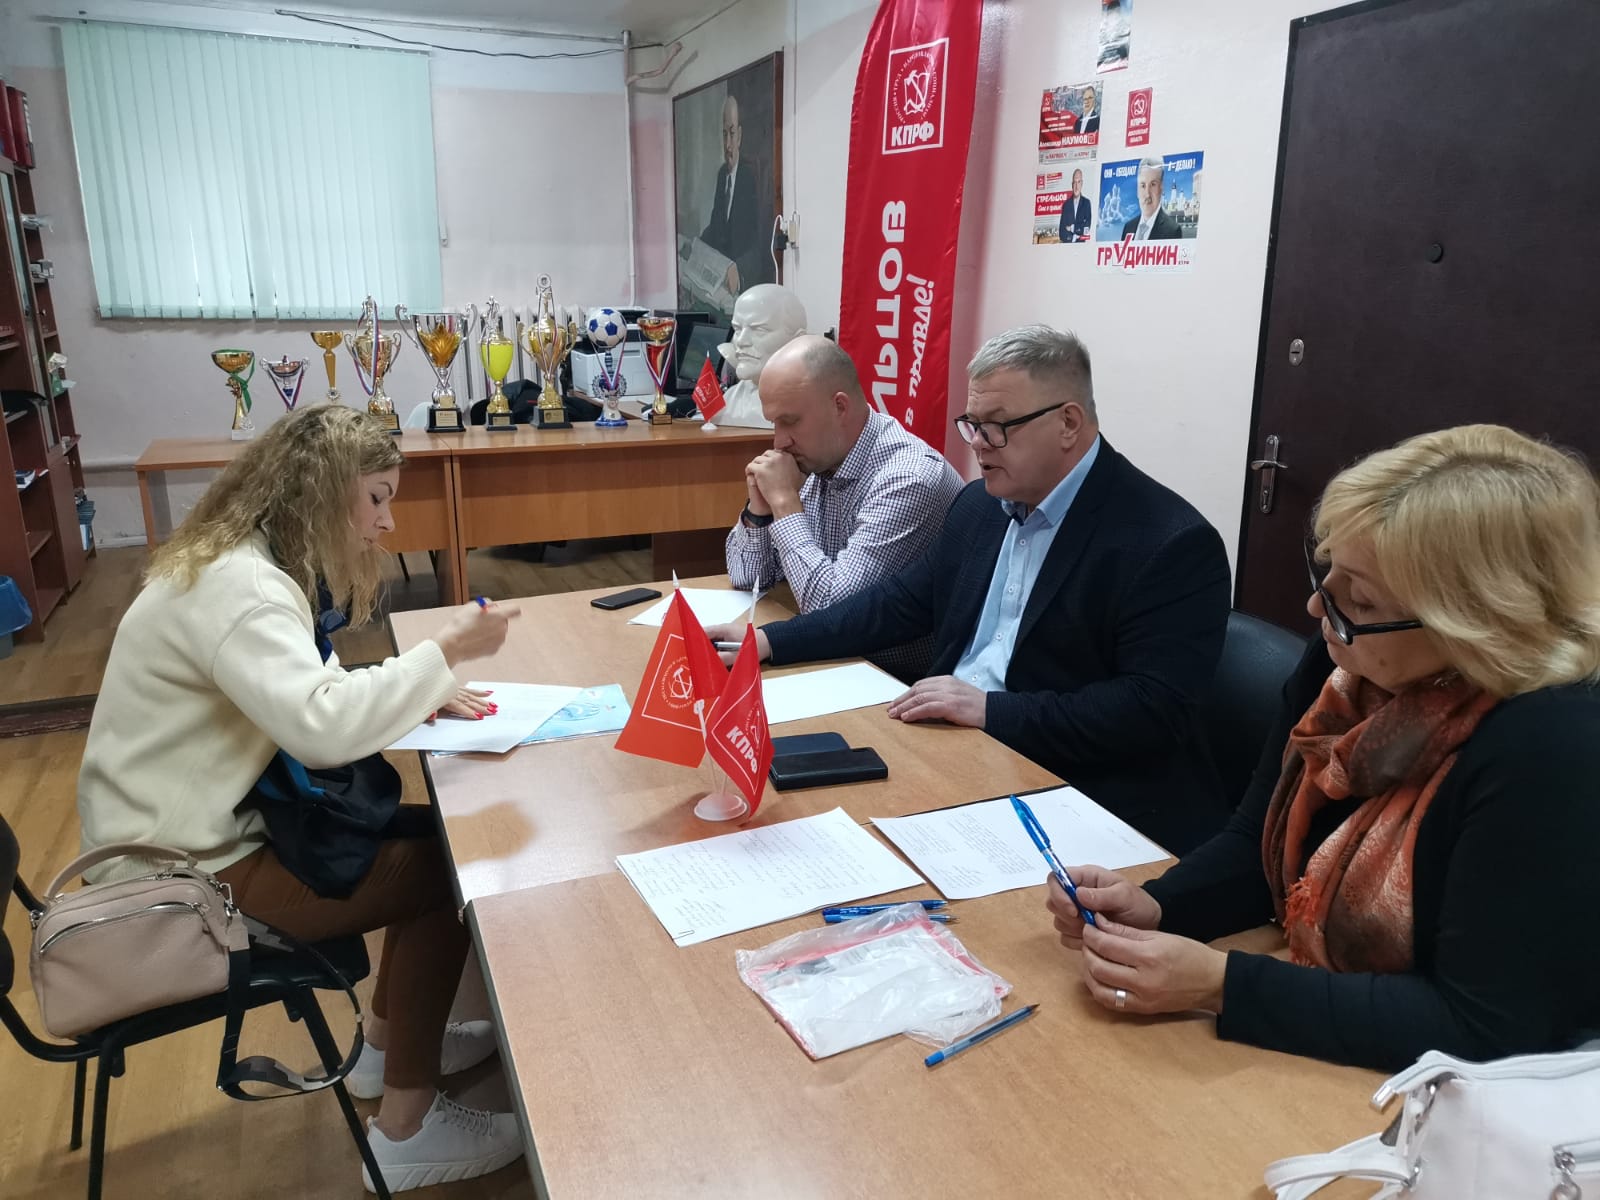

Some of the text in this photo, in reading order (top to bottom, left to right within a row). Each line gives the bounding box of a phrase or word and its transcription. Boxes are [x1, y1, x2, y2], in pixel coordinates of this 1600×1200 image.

[1130, 117, 1146, 126] КПРФ
[891, 121, 934, 146] КПРФ
[1061, 135, 1088, 145] НАУМОВ
[1104, 168, 1113, 179] ОНИ
[1036, 194, 1067, 203] СТРЕЛЬЦОВ
[1097, 234, 1178, 269] ГРУДИНИН
[726, 725, 758, 774] КПРФ
